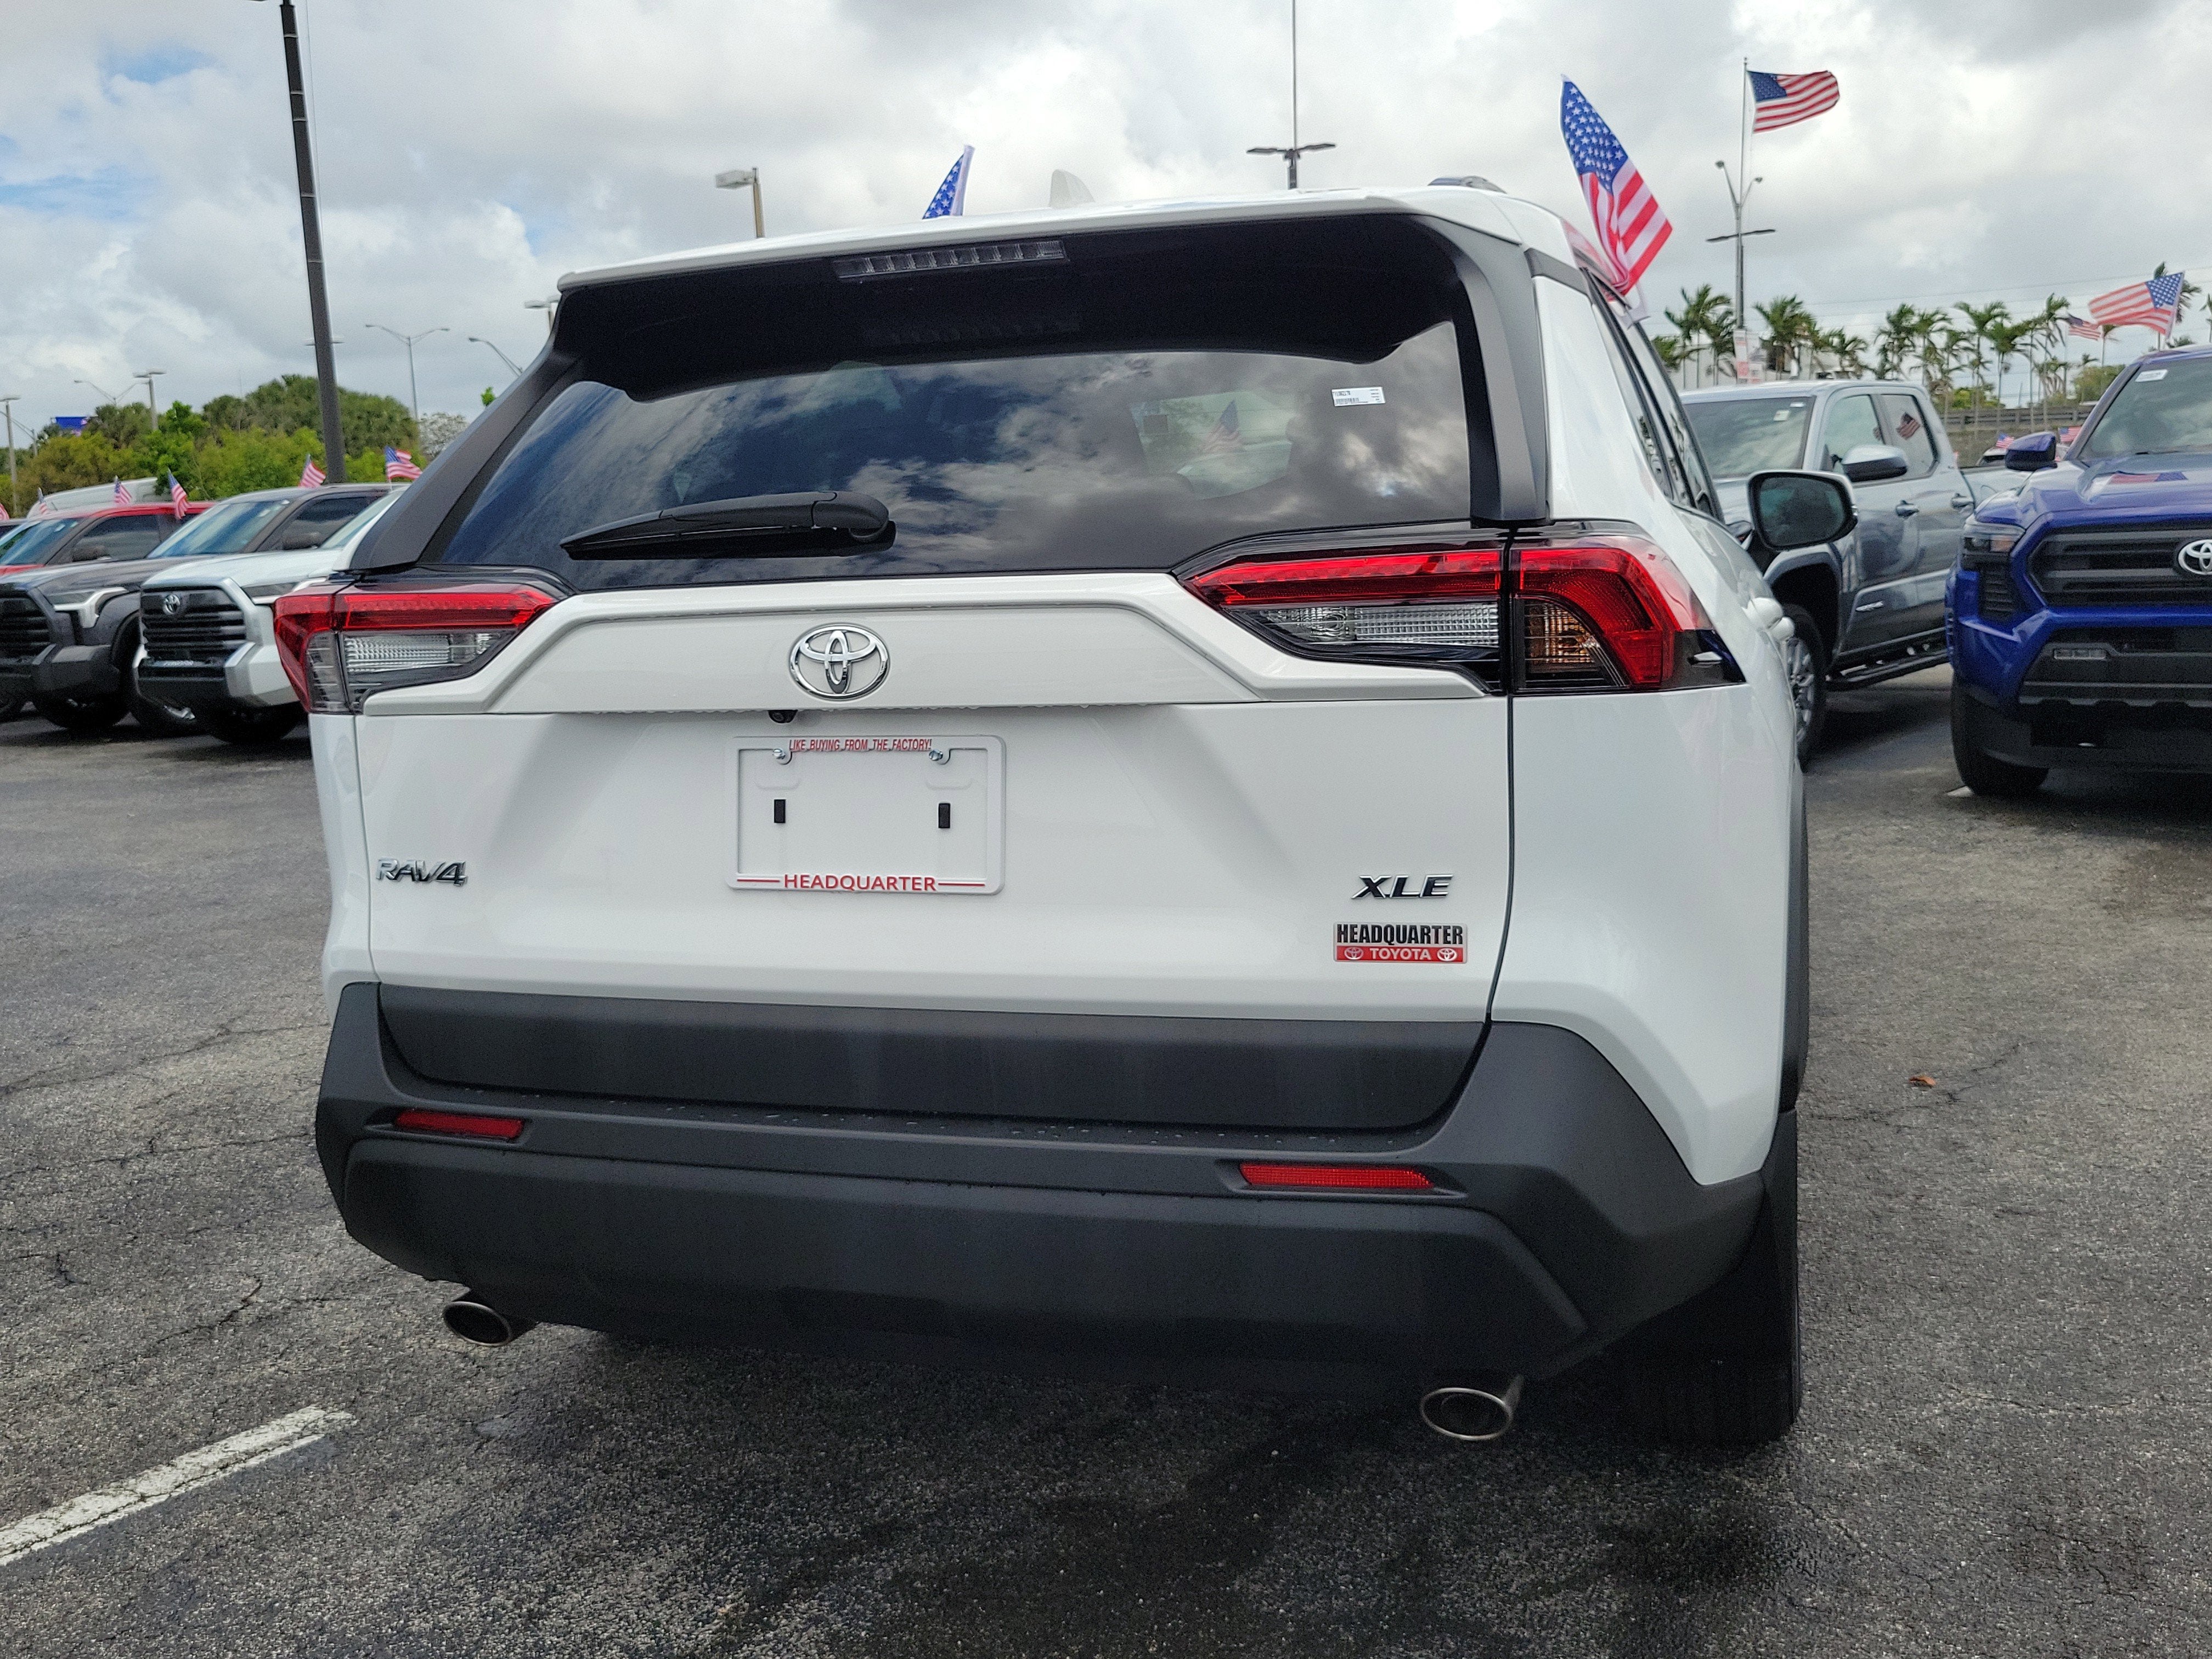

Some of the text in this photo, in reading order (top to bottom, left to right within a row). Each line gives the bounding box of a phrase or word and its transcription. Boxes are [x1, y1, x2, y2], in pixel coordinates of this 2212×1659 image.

[789, 738, 932, 751] LIKE BUYING FROM THE FACTORY!
[376, 859, 468, 887] RAV4
[784, 874, 936, 891] HEADQUARTER
[1351, 874, 1454, 899] XLE
[1337, 924, 1463, 945] HEADQUARTER
[1369, 947, 1431, 960] TOYOTA
